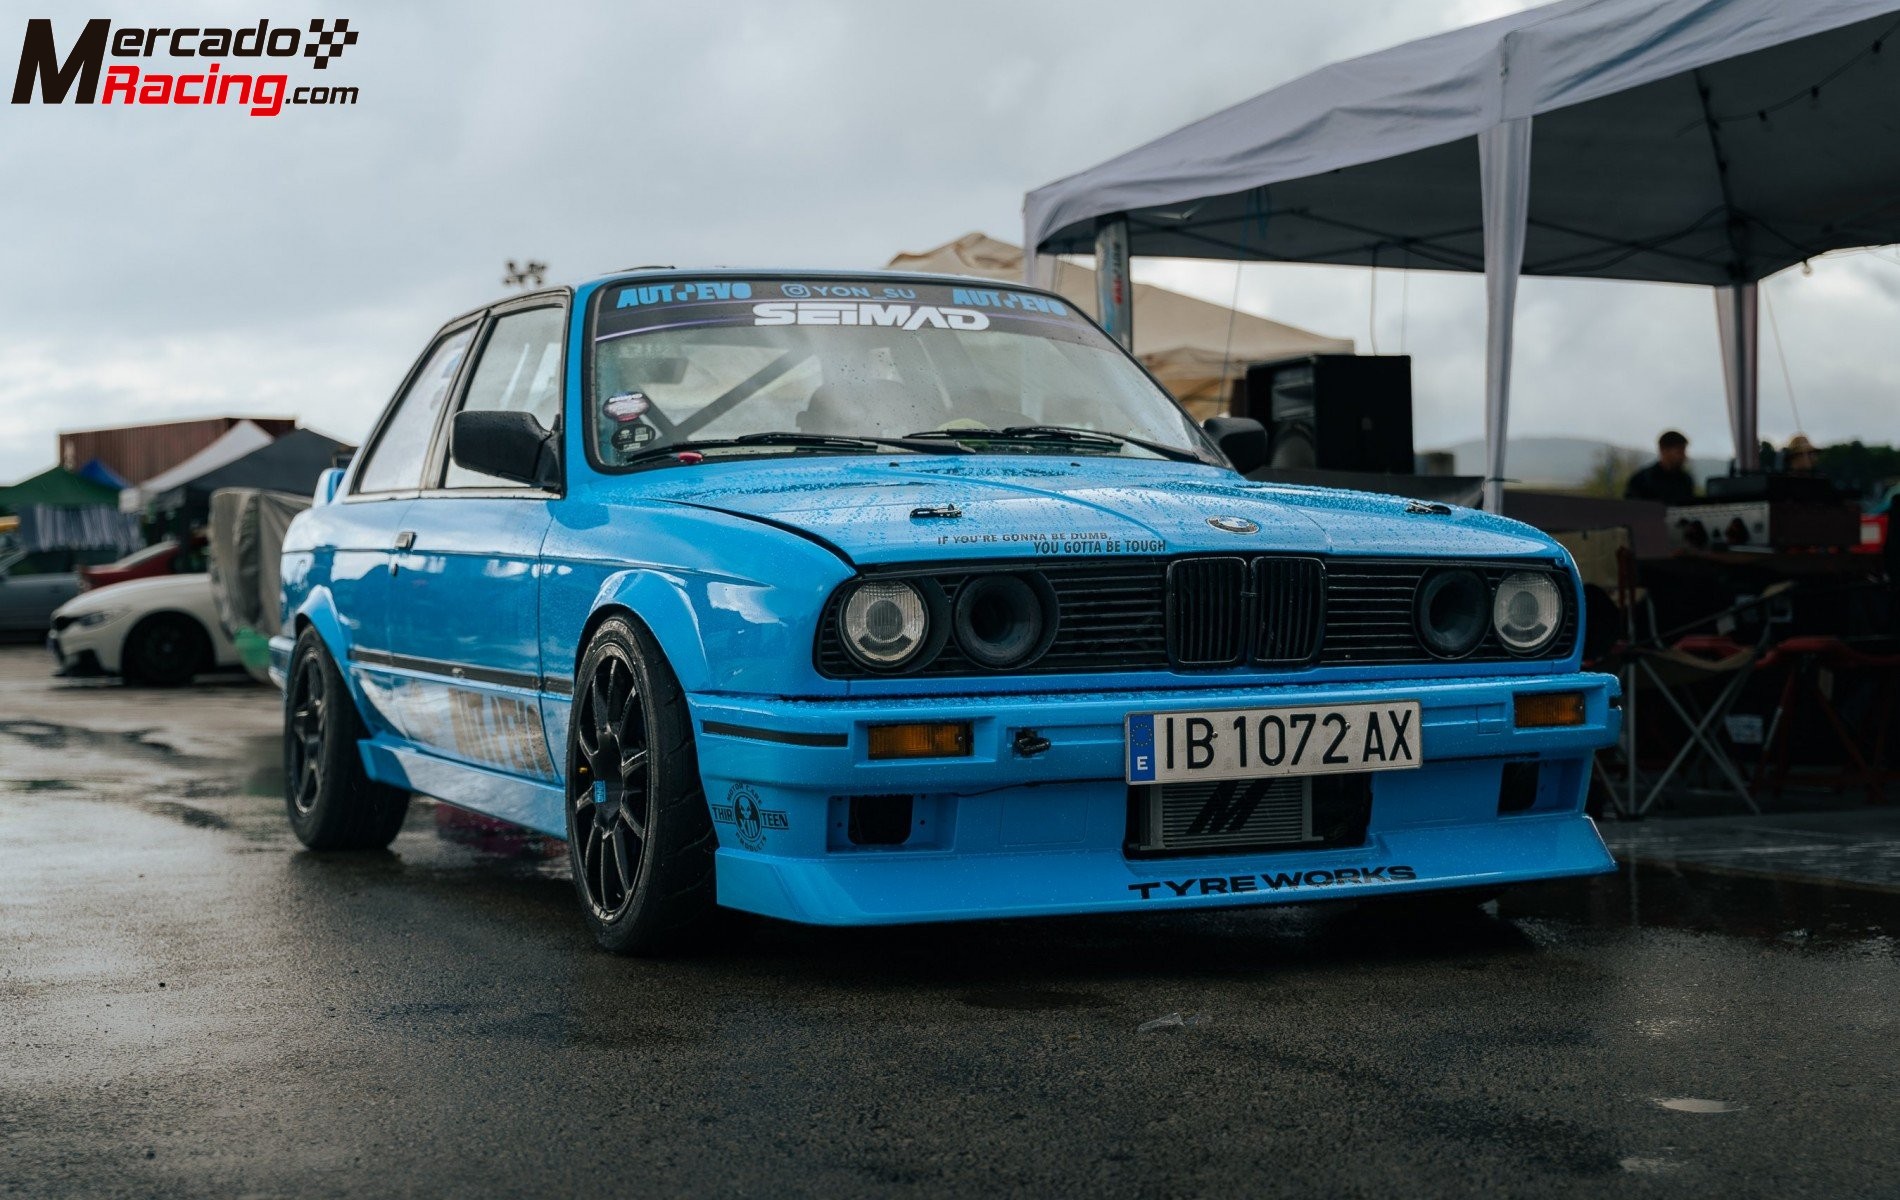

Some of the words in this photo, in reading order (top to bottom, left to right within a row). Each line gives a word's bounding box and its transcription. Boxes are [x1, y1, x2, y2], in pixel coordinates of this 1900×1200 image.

[752, 302, 991, 331] SEIMAD
[937, 536, 949, 545] IF
[953, 534, 997, 544] YOU'RE
[1002, 533, 1047, 542] GONNA
[1051, 532, 1067, 541] BE
[1070, 532, 1112, 541] DUMB,
[1034, 541, 1059, 554] YOU
[1063, 540, 1102, 553] GOTTA
[1106, 540, 1121, 553] BE
[1125, 539, 1166, 552] TOUGH
[1166, 717, 1215, 770] IB
[1233, 712, 1349, 768] 1072
[1362, 709, 1412, 763] AX
[1136, 755, 1148, 771] E
